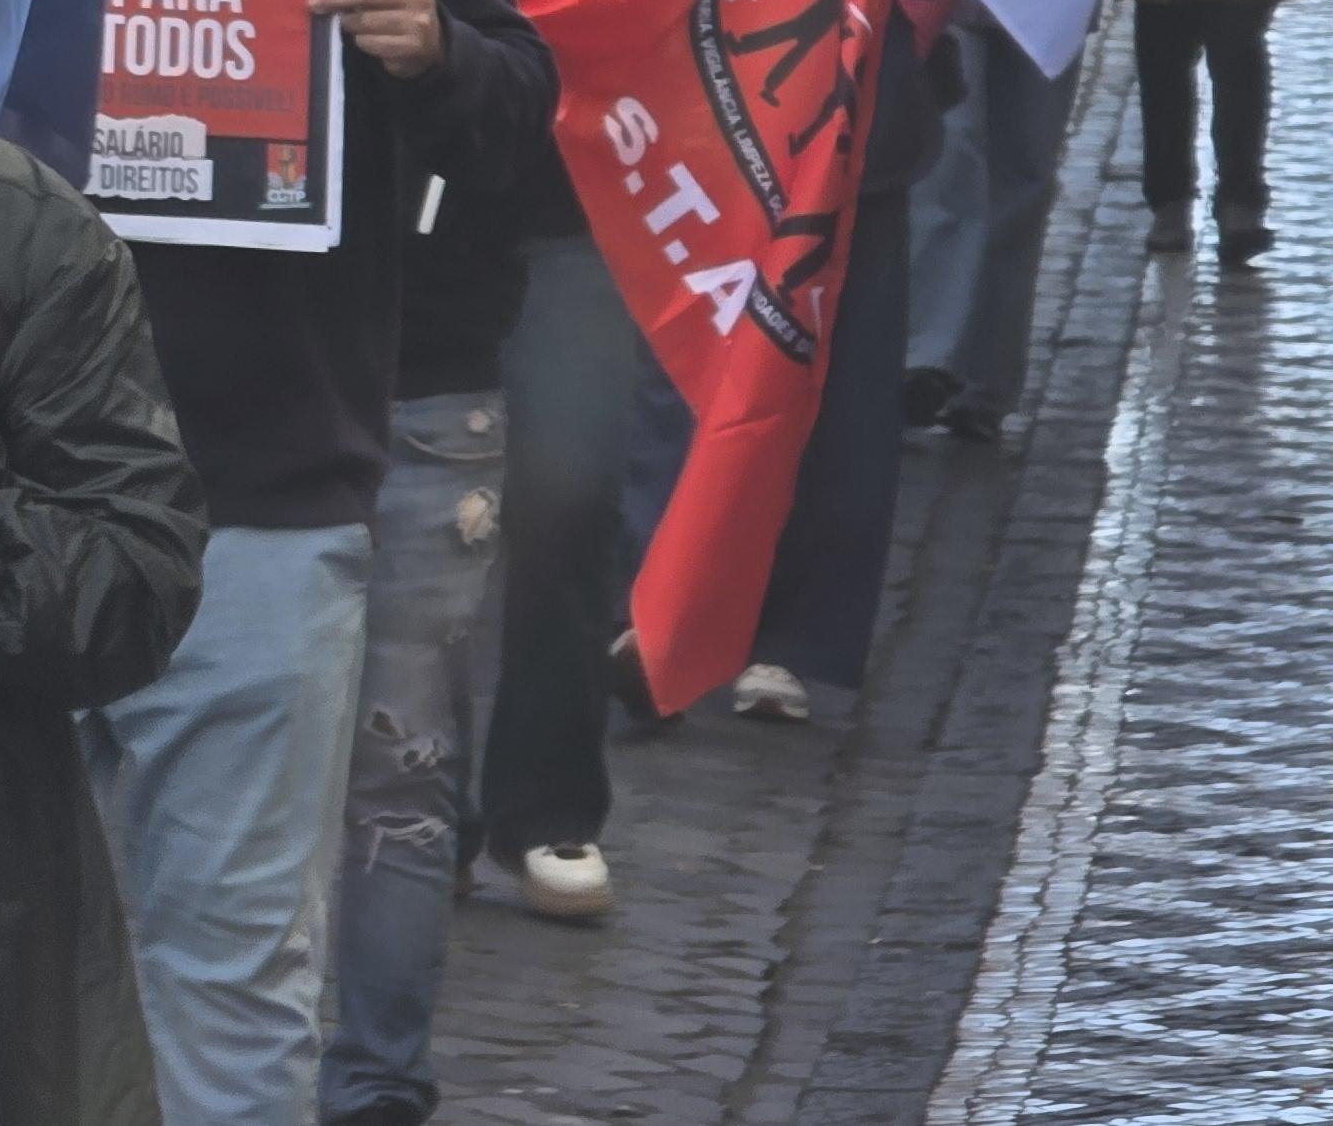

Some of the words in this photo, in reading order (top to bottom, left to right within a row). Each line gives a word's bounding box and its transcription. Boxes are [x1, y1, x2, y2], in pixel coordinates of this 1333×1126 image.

[101, 12, 257, 81] TODOS
[91, 125, 184, 159] SALÁRIO
[99, 163, 200, 195] DIREITOS
